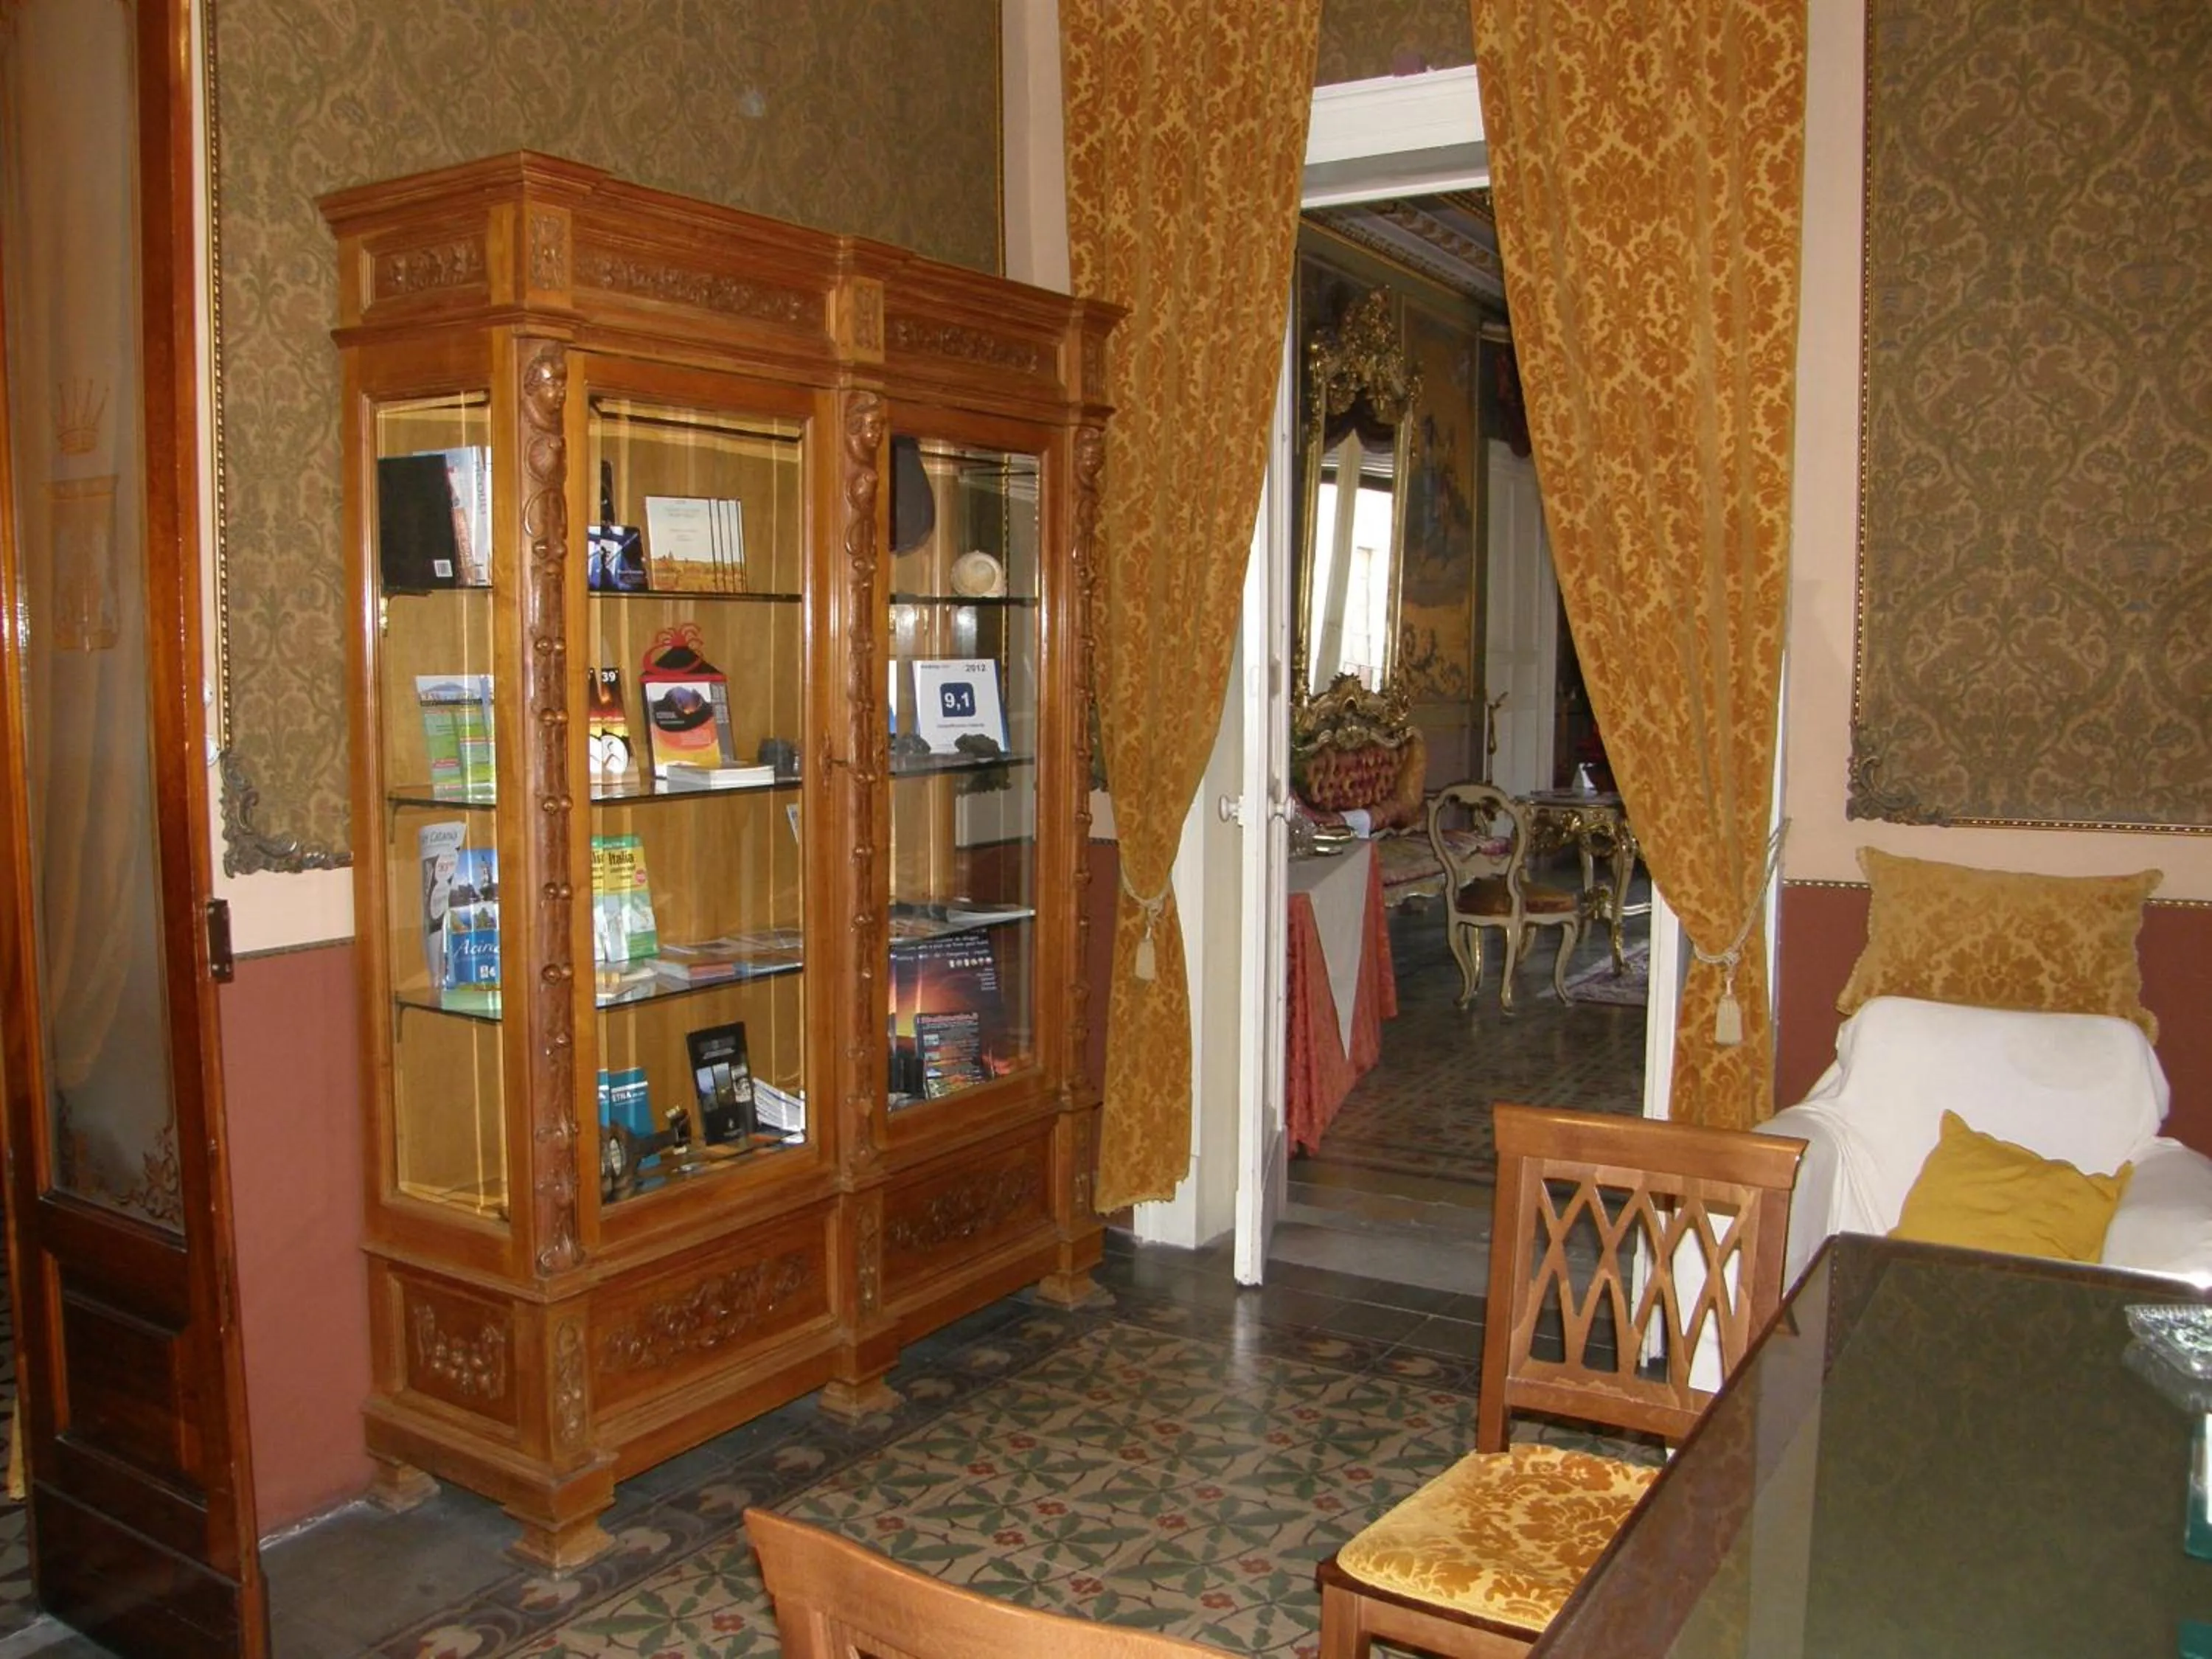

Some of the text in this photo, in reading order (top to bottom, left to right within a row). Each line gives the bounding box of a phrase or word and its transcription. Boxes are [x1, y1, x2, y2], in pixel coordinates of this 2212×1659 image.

[965, 664, 987, 672] 2012
[945, 692, 970, 711] 9,1
[608, 850, 635, 866] Italia
